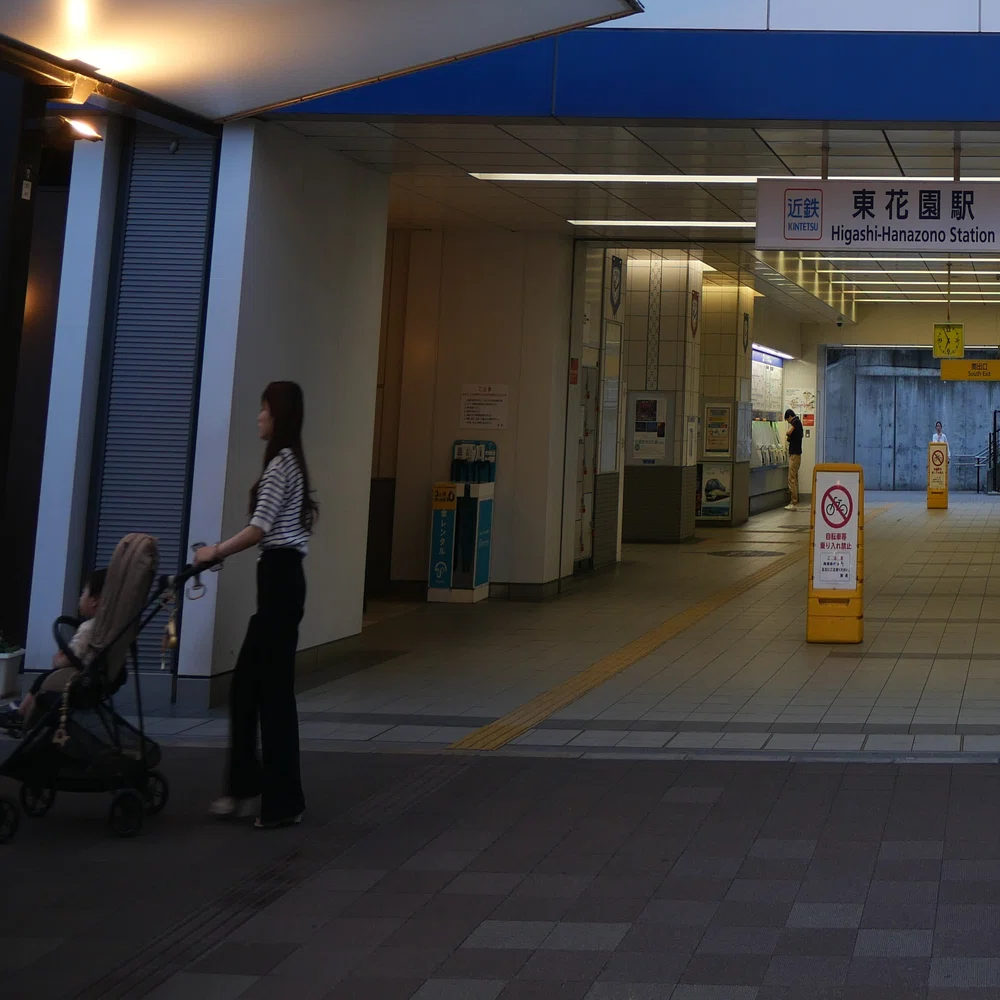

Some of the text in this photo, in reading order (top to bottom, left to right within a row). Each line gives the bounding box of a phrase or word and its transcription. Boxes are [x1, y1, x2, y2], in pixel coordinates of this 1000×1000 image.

[786, 197, 820, 219] 近鉄
[851, 188, 975, 221] 東花園駅
[787, 222, 819, 232] KINTETSU
[830, 224, 996, 246] Higashi-Hanazono Station
[820, 542, 852, 550] 乗り入れ禁止
